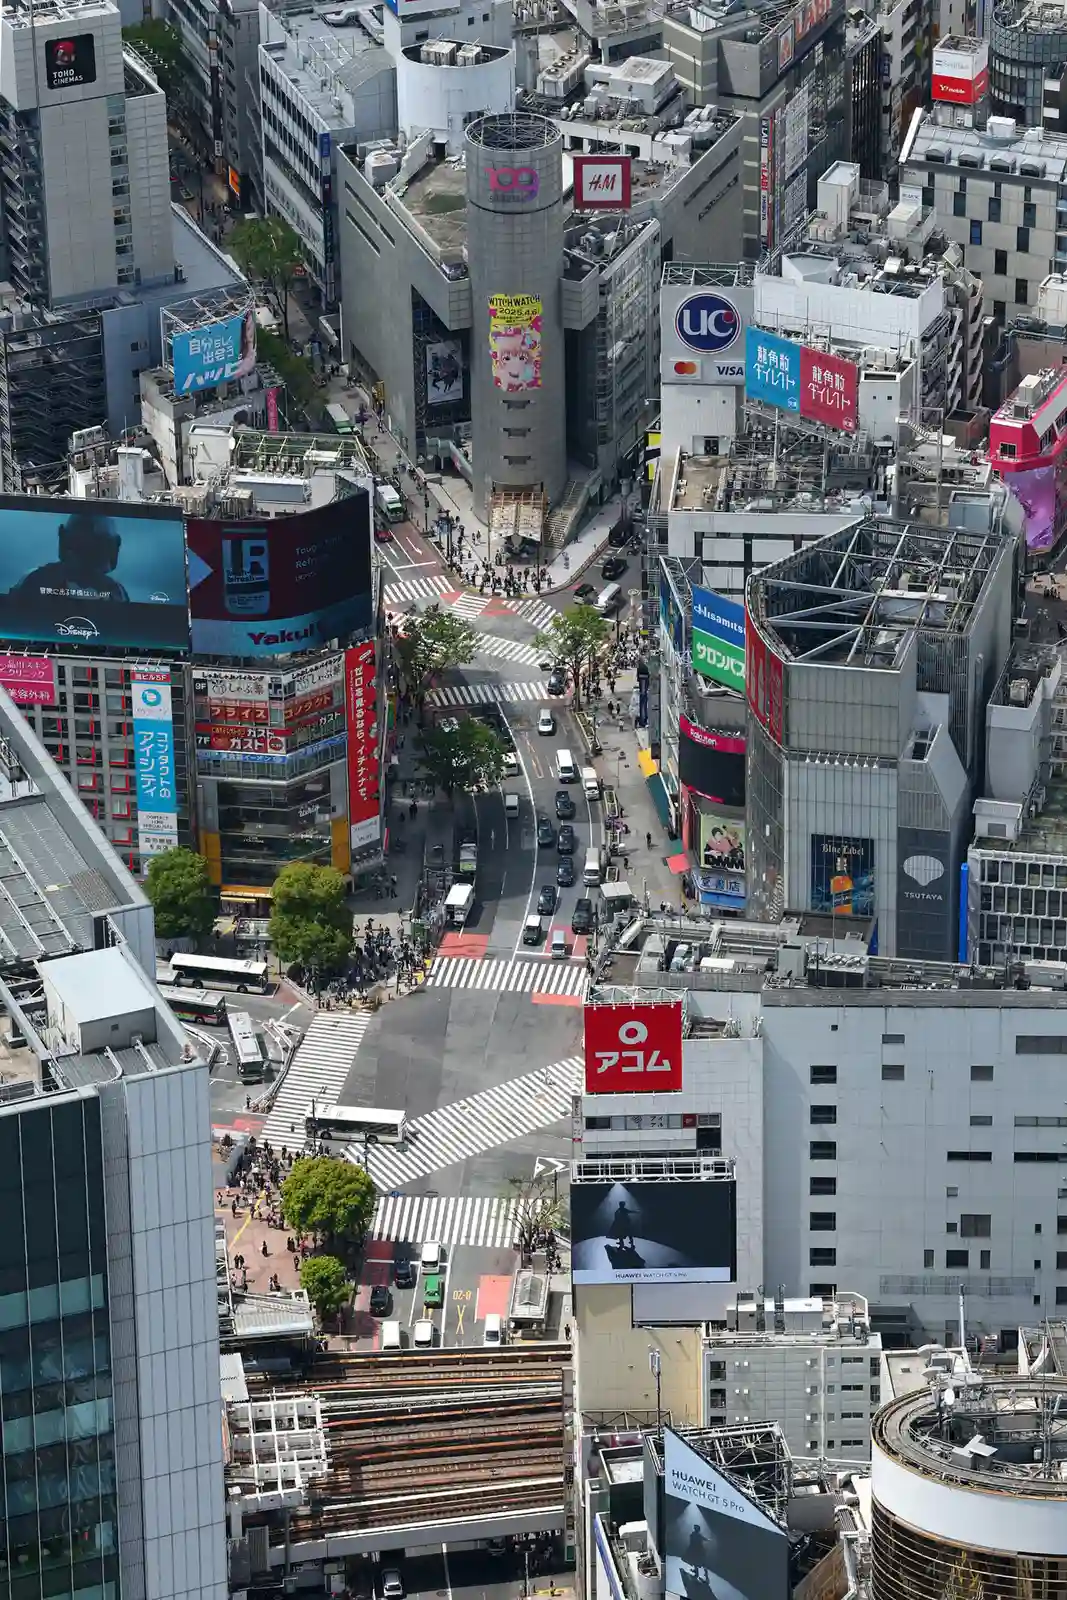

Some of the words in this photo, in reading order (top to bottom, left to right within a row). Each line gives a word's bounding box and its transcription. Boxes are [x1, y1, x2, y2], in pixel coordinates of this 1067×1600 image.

[52, 69, 75, 79] TOHO
[52, 75, 84, 86] CINEMAS
[588, 174, 617, 191] H&M
[760, 168, 768, 191] LABI
[682, 309, 735, 338] UC
[756, 345, 791, 372] 龍角散
[716, 366, 744, 376] VISA
[811, 365, 846, 392] 龍角散
[54, 621, 100, 640] Disney+
[195, 682, 207, 690] 9F
[197, 736, 210, 745] 7F
[247, 728, 275, 738] ガスト
[229, 736, 265, 751] ガスト
[138, 731, 157, 798] アイシティ
[156, 731, 171, 799] コンタクトの
[820, 843, 841, 854] Blue
[842, 844, 864, 856] Label
[903, 891, 944, 901] TSUTAYA
[594, 1050, 672, 1074] アコム
[671, 1468, 717, 1493] HUAWEI
[671, 1480, 707, 1500] WATCH
[707, 1492, 721, 1505] GT
[722, 1497, 729, 1508] 5
[729, 1500, 746, 1514] Pro
